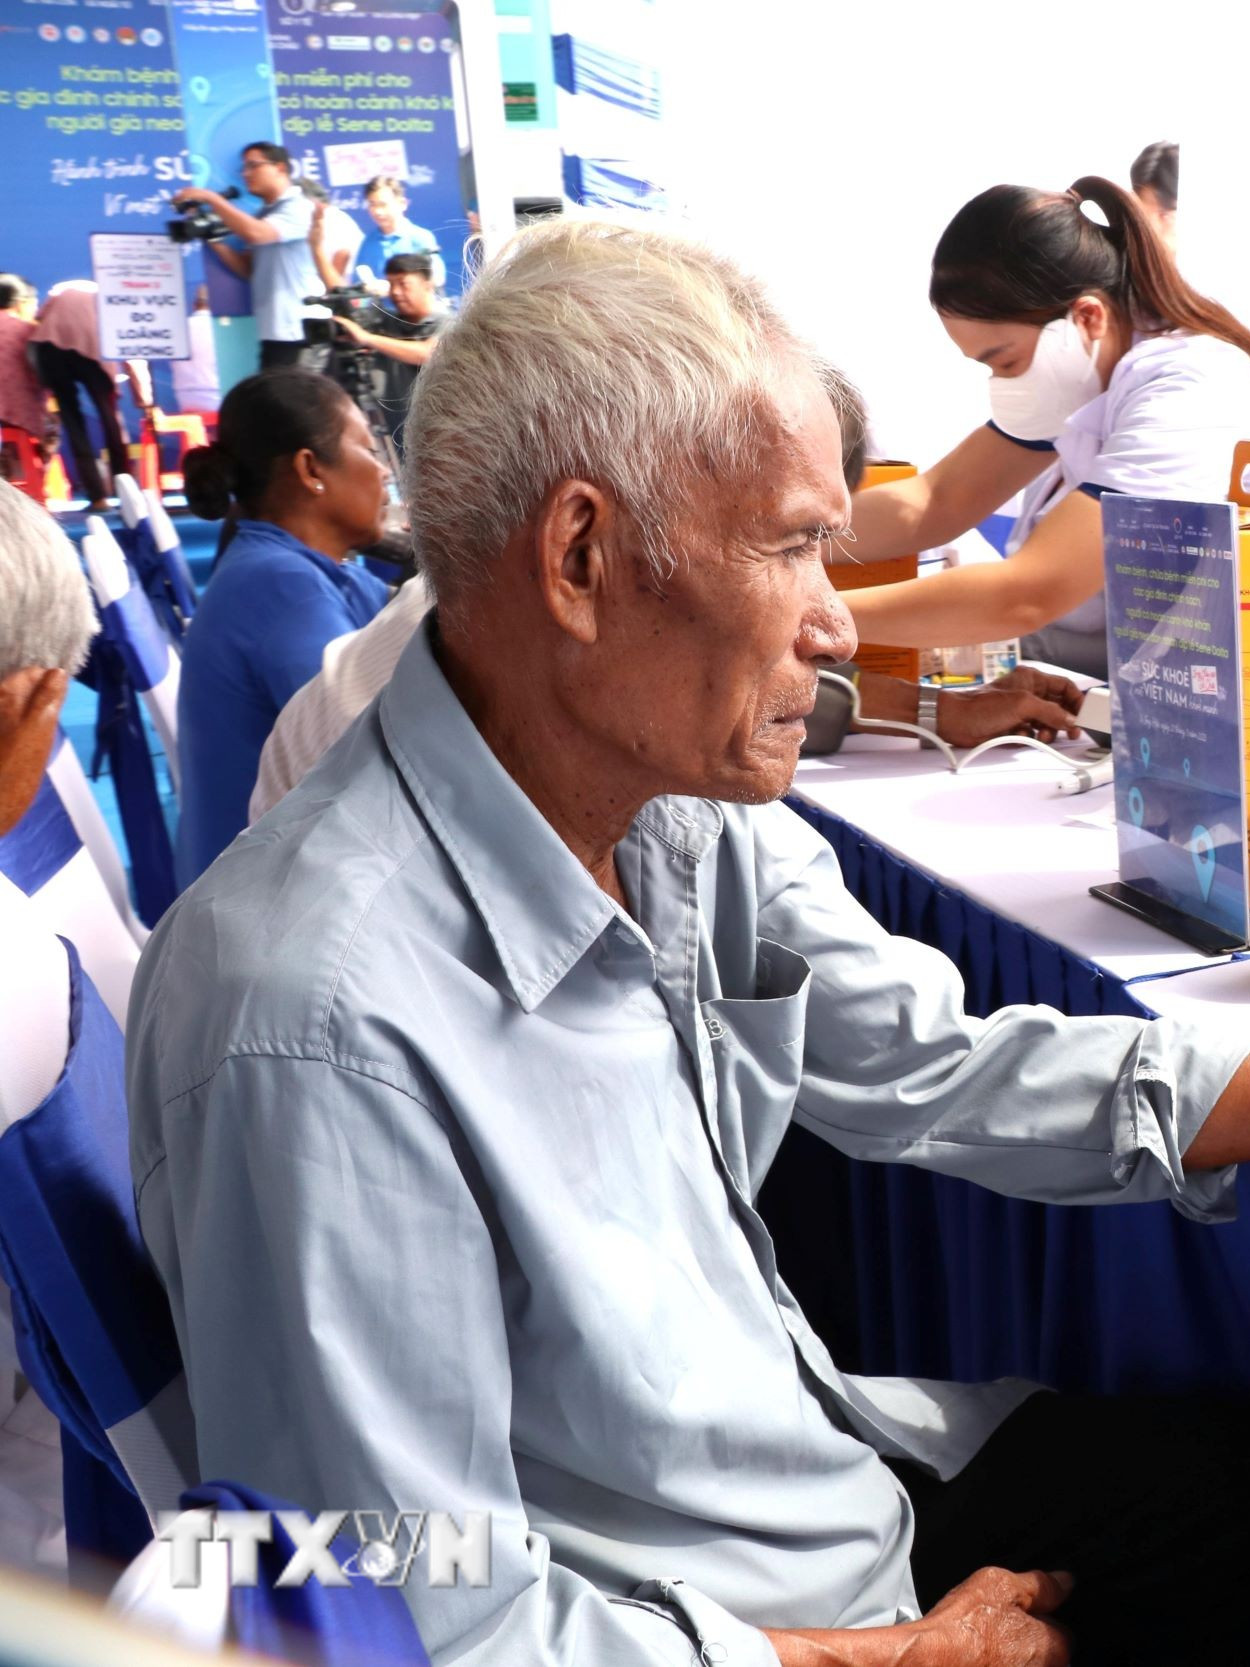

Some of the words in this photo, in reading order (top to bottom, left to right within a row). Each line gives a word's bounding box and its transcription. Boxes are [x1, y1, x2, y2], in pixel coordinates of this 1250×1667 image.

[60, 65, 123, 82] Khám
[125, 67, 181, 88] bệnh
[376, 73, 412, 88] cho
[1162, 666, 1190, 688] KHOẺ
[1143, 680, 1163, 704] VIỆT
[1164, 689, 1188, 709] NAM
